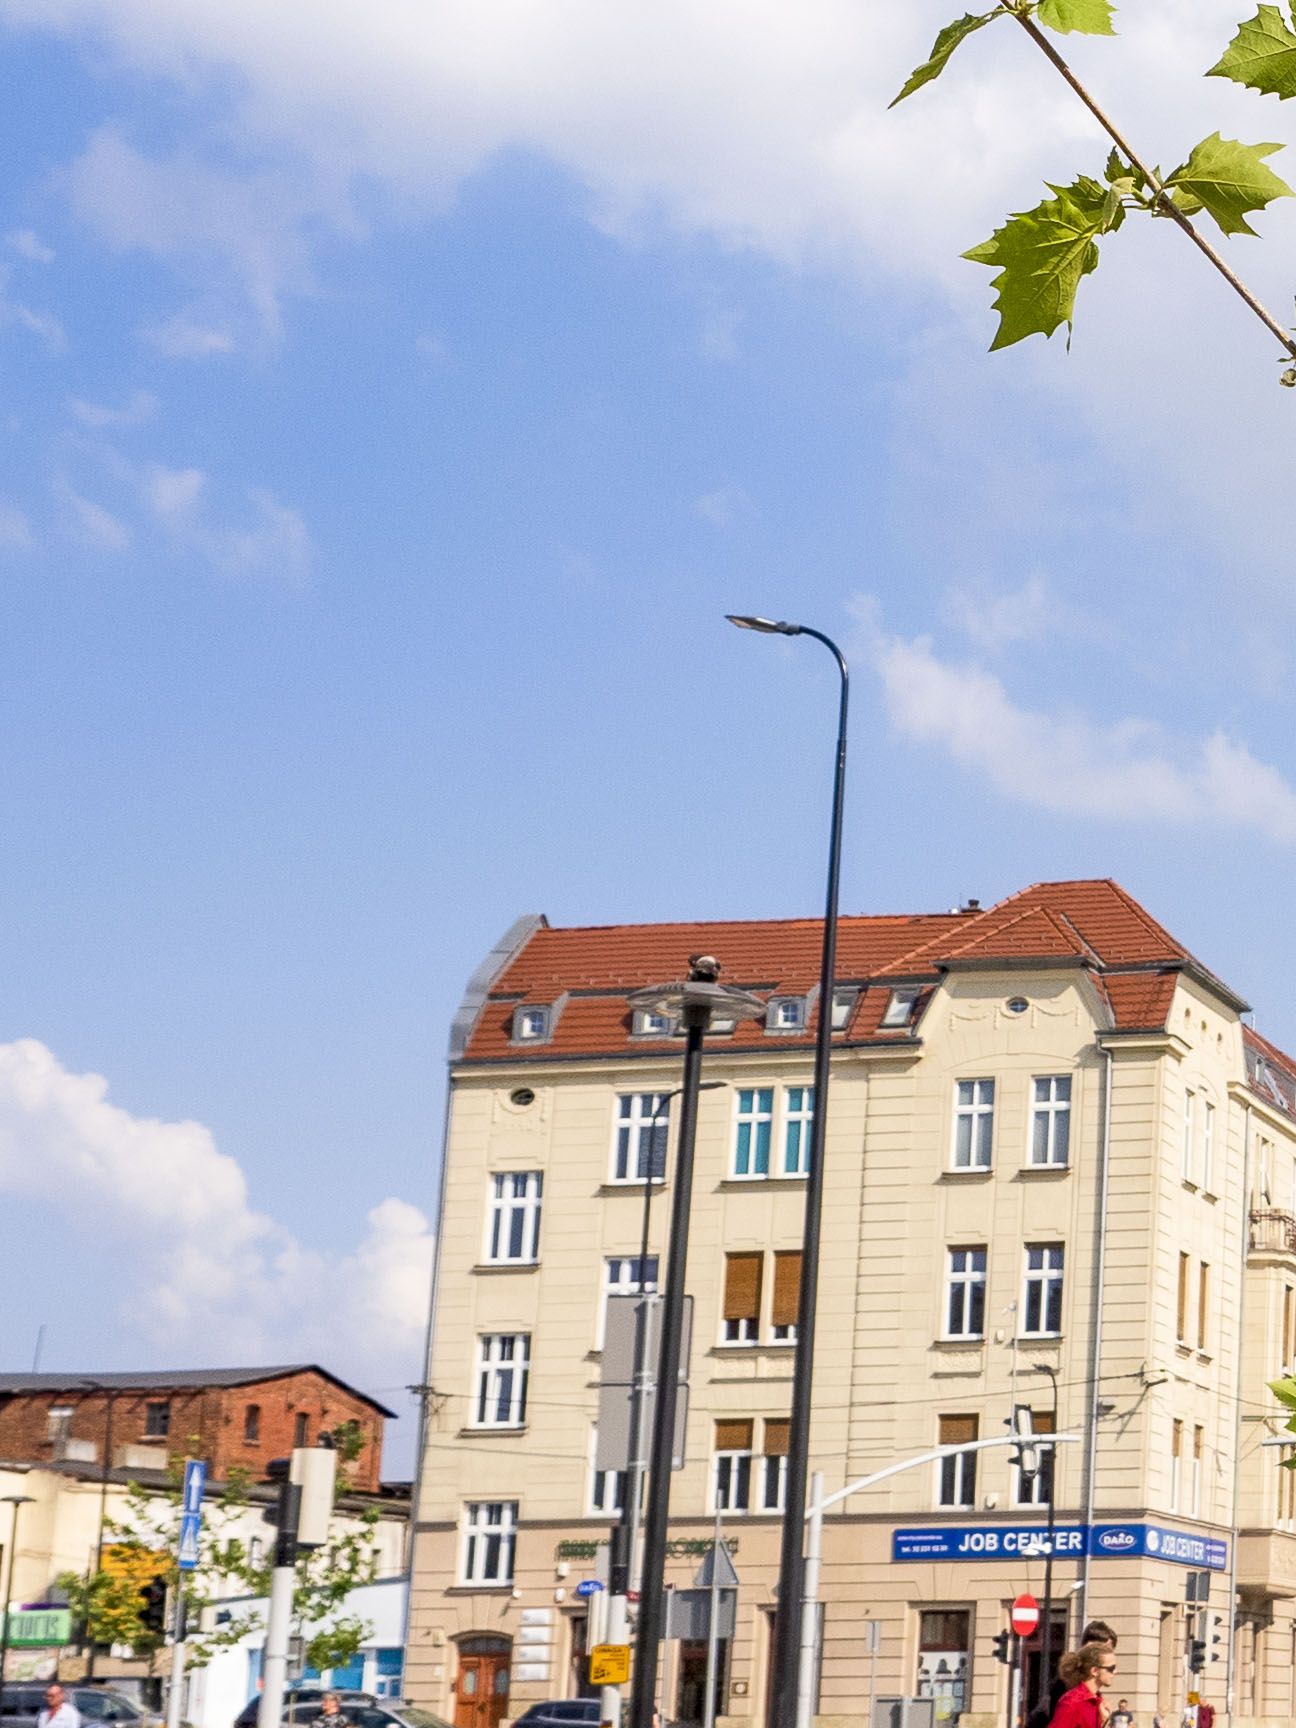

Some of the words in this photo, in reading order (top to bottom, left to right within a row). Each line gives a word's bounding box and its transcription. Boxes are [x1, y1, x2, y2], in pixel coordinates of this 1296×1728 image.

[958, 1532, 999, 1552] JOB
[1160, 1534, 1177, 1555] JOB
[1177, 1537, 1204, 1560] CENTER
